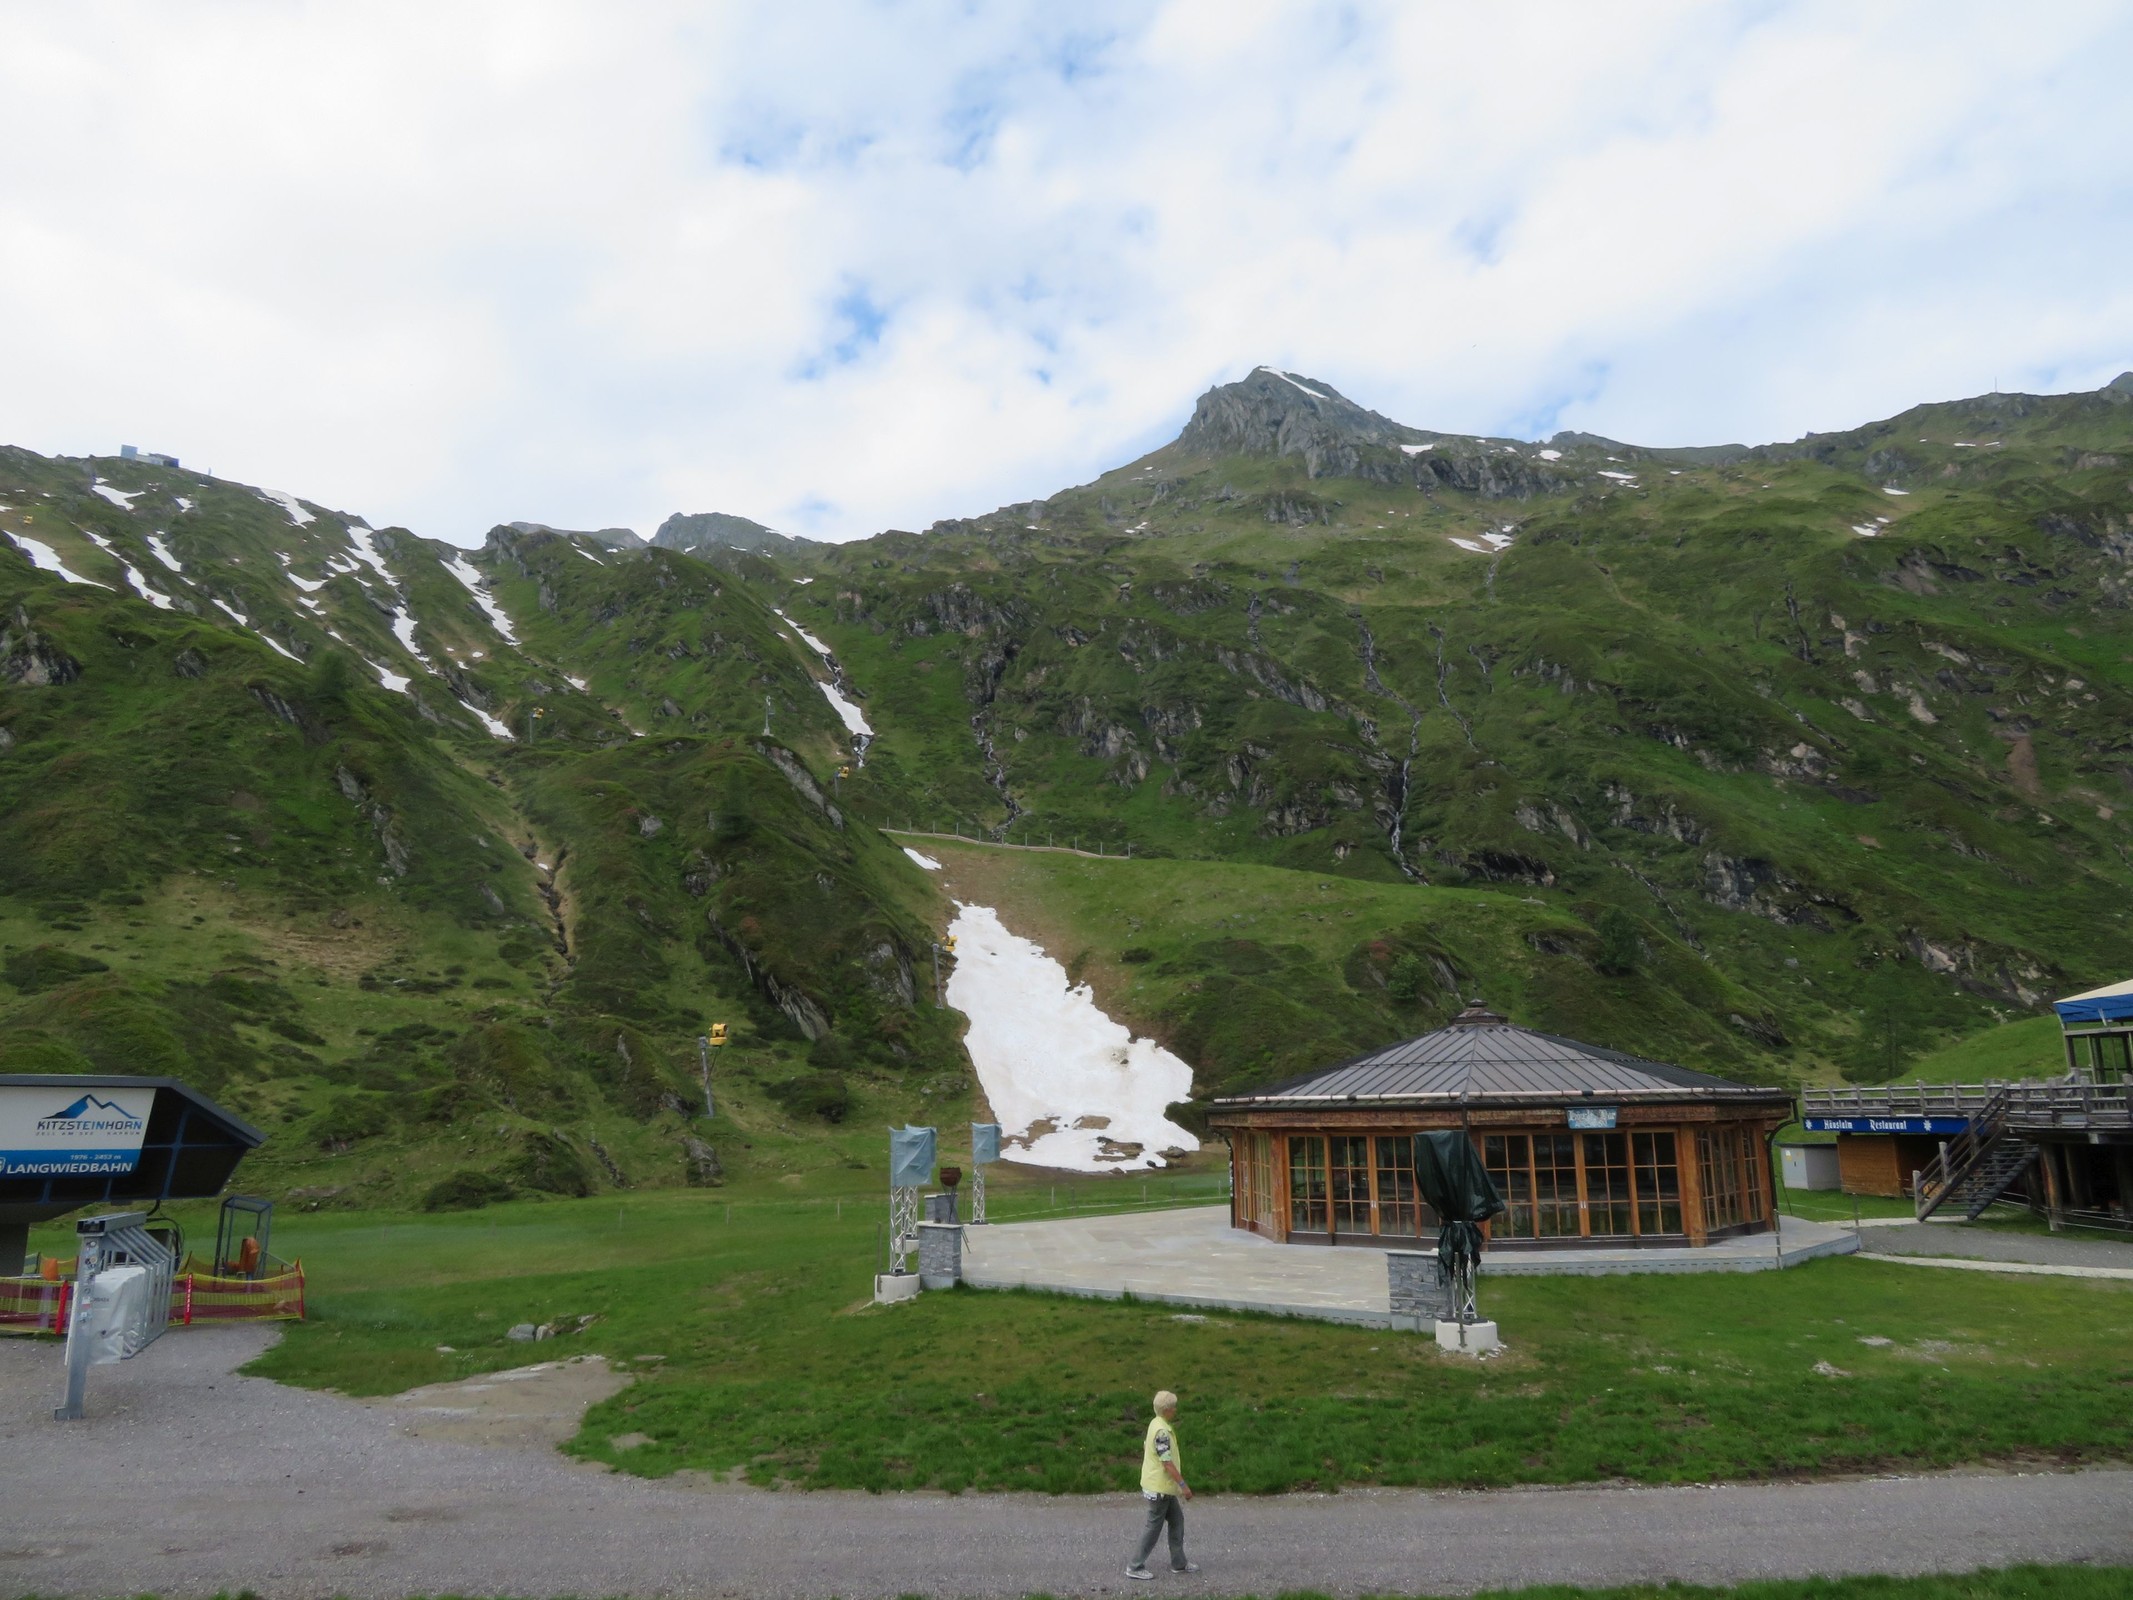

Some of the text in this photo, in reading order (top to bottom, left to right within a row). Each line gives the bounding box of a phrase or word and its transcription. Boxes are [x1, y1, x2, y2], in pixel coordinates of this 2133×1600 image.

[37, 1121, 142, 1130] KITZSTEINHORN
[1869, 1119, 1907, 1131] Restaurant
[7, 1163, 132, 1174] LANGWIEDBAHN
